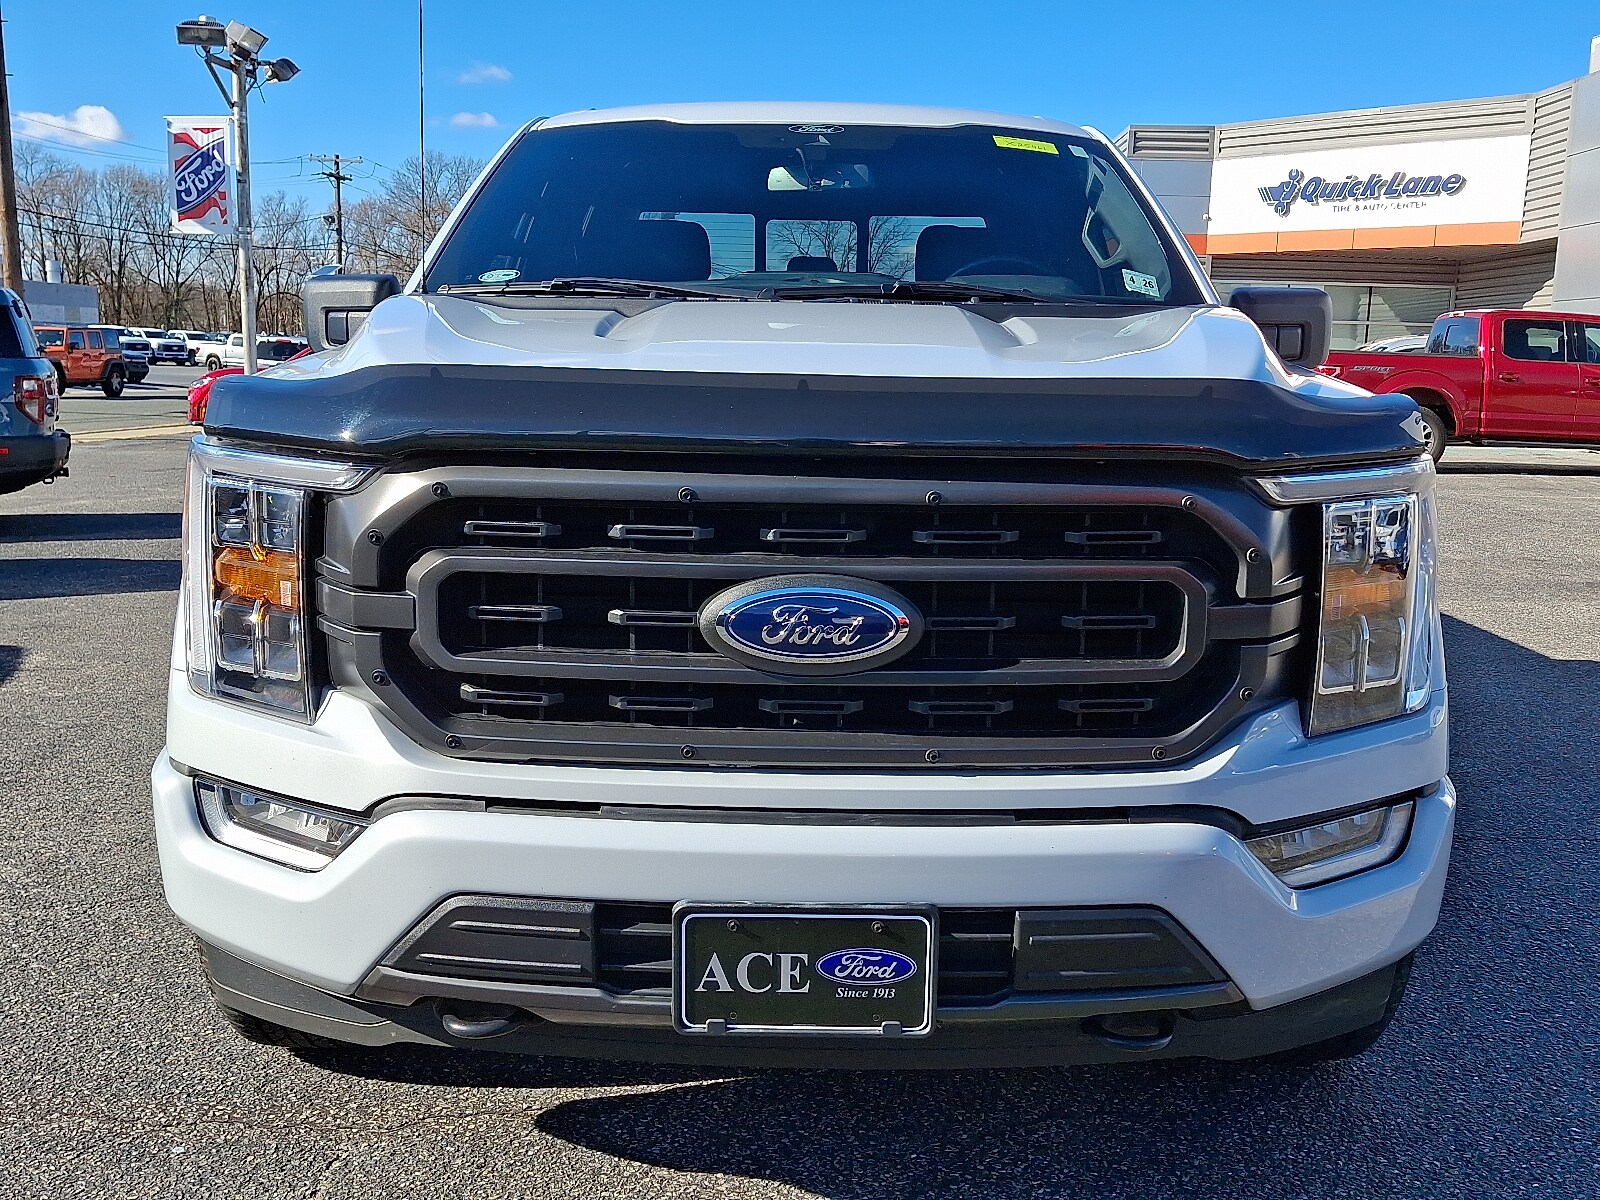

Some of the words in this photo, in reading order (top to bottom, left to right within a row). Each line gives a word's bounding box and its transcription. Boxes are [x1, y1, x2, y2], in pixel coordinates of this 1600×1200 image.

[175, 149, 225, 202] Ford
[1301, 174, 1381, 203] Quick
[1384, 171, 1464, 197] Lane
[1332, 204, 1350, 213] TIRE
[1363, 203, 1388, 211] AUTO
[1390, 201, 1427, 210] CENTER
[1129, 275, 1136, 285] 4
[1142, 278, 1154, 289] 26
[761, 604, 864, 646] Ford
[694, 951, 811, 994] ACE
[834, 954, 896, 979] Ford
[835, 987, 869, 999] Since
[871, 987, 896, 999] 1913
